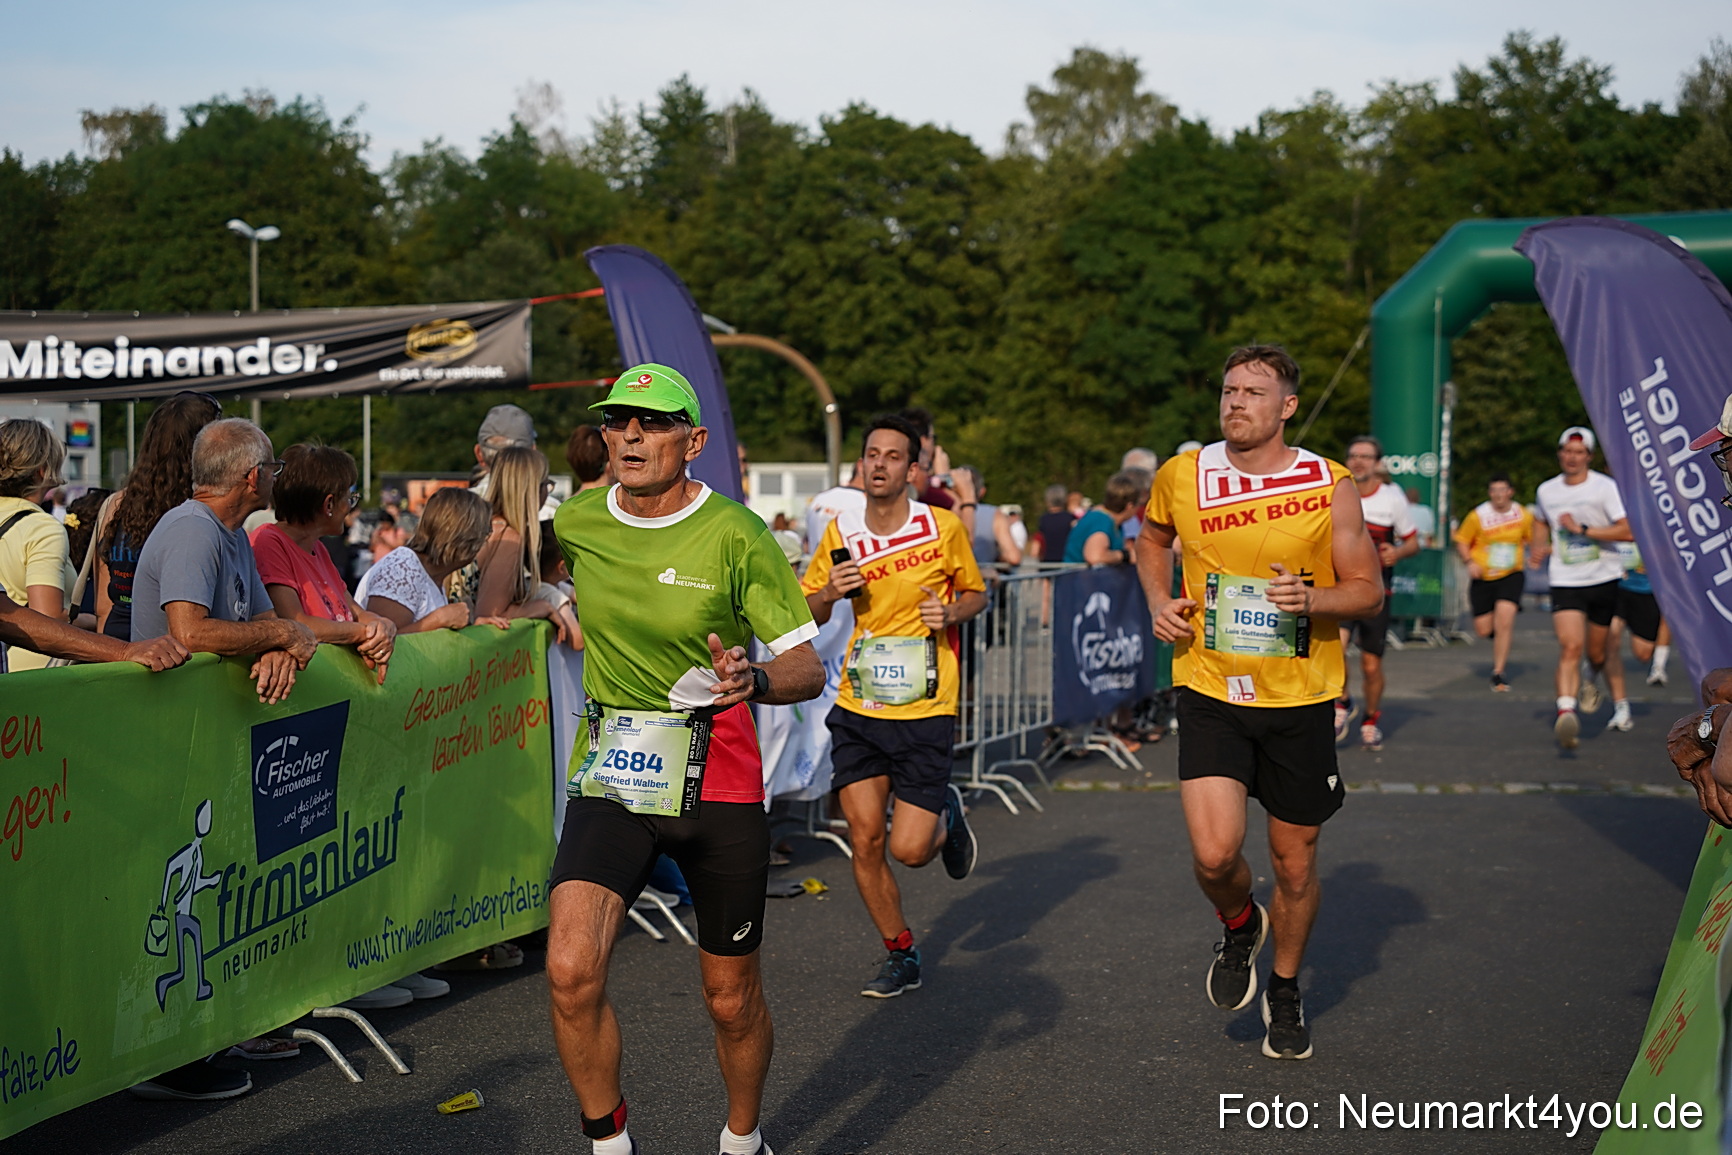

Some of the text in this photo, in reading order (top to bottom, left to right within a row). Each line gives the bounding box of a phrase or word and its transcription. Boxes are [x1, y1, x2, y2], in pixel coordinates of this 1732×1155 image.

[0, 335, 338, 379] Miteinander.
[1200, 494, 1331, 534] MAX BÖGL
[894, 547, 943, 573] BÖGL
[675, 580, 716, 590] NEUMARKT
[1233, 608, 1279, 628] 1686
[873, 665, 905, 679] 1751
[404, 648, 535, 731] Gesunde Firmen
[431, 715, 484, 774] laufen
[602, 748, 664, 774] 2684
[267, 749, 330, 787] Fischer
[272, 771, 322, 799] AUTOMOBILE
[593, 772, 631, 787] Siegfried
[633, 779, 669, 790] Walbert
[684, 780, 695, 811] HILTL
[217, 785, 405, 947] firmenlauf
[347, 866, 551, 970] www.firmenlauf-oberpfalz.d
[223, 914, 308, 984] neumarkt
